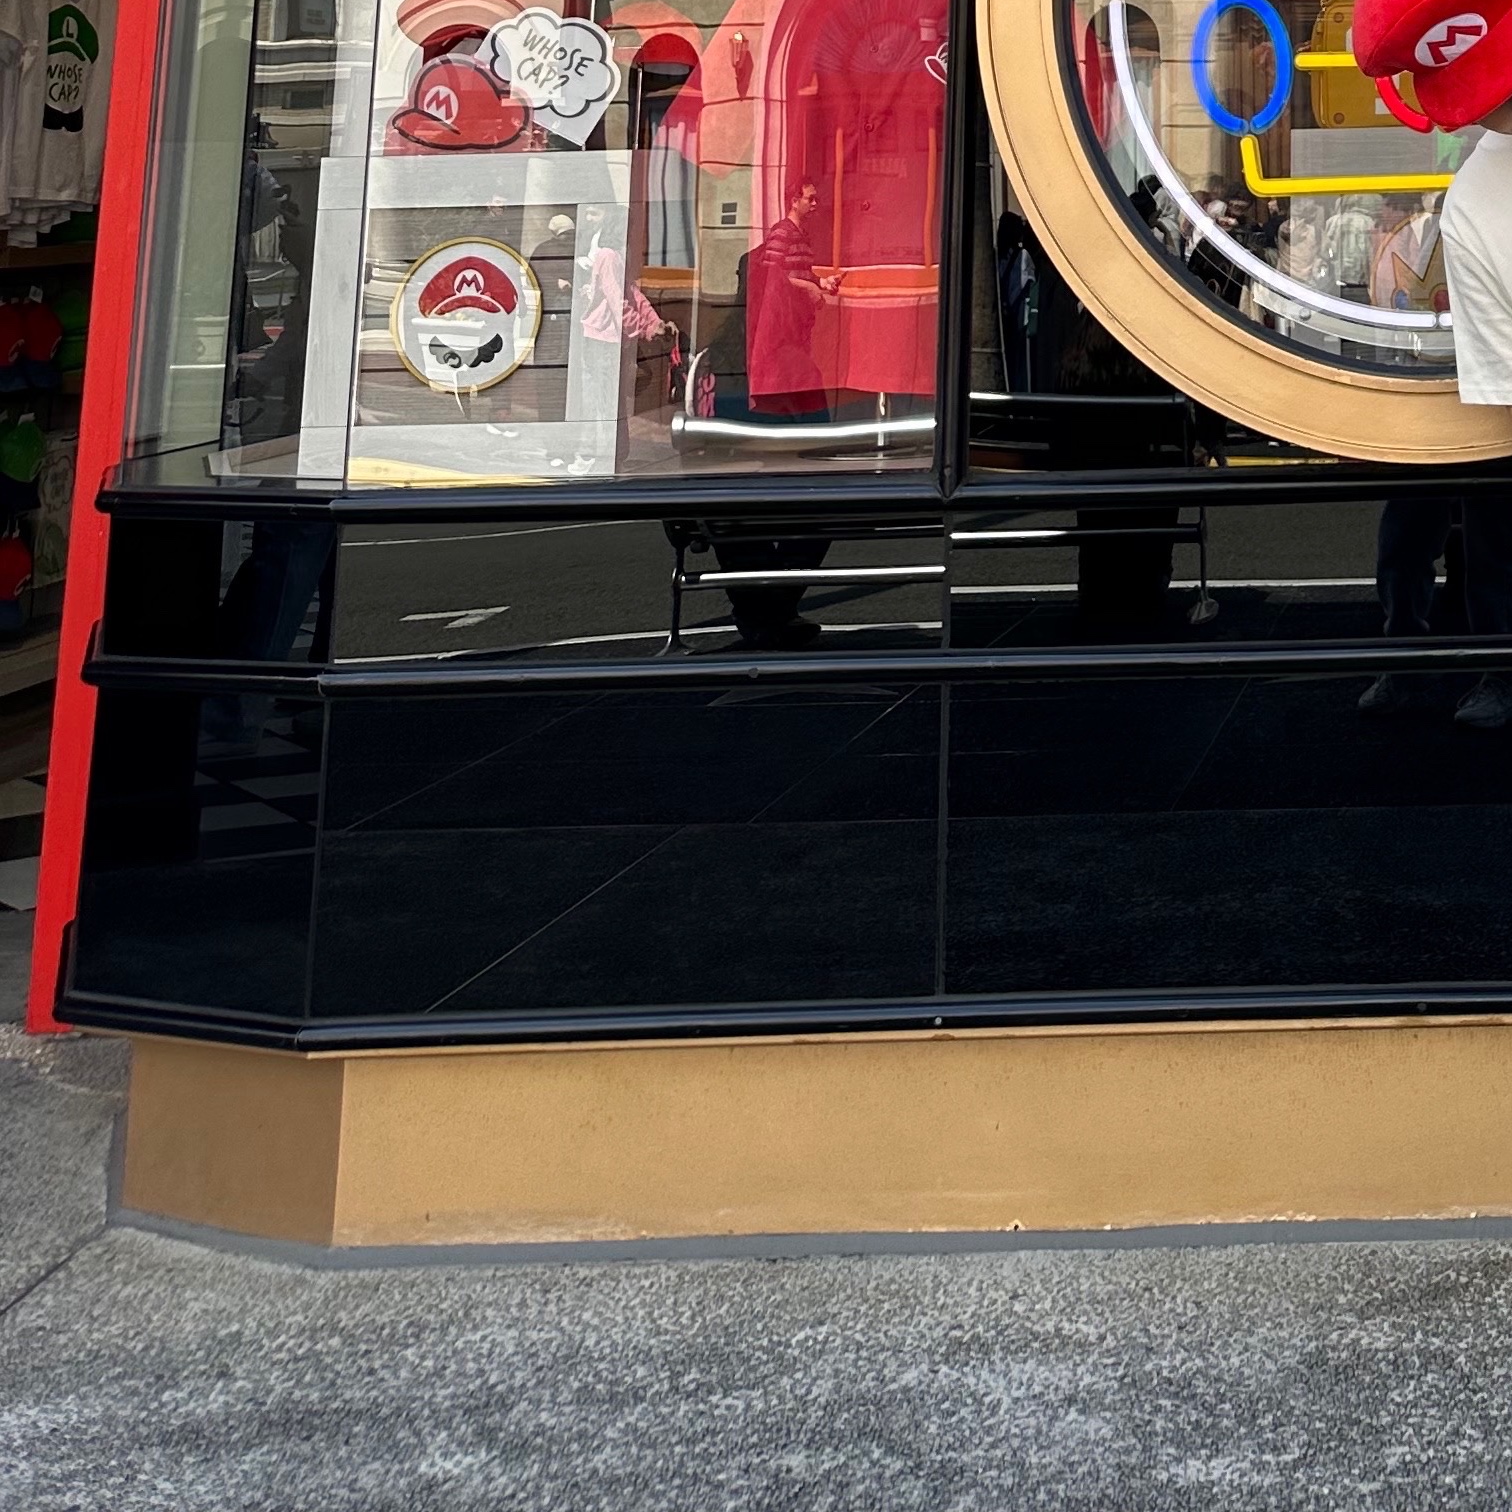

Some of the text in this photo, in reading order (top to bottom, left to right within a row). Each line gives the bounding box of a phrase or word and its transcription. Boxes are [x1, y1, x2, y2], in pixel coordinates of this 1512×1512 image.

[522, 28, 595, 77] WHOSE
[1426, 24, 1484, 65] M
[516, 56, 570, 95] CAP?
[48, 82, 80, 105] CAP?
[425, 89, 454, 121] M
[456, 273, 483, 294] M
